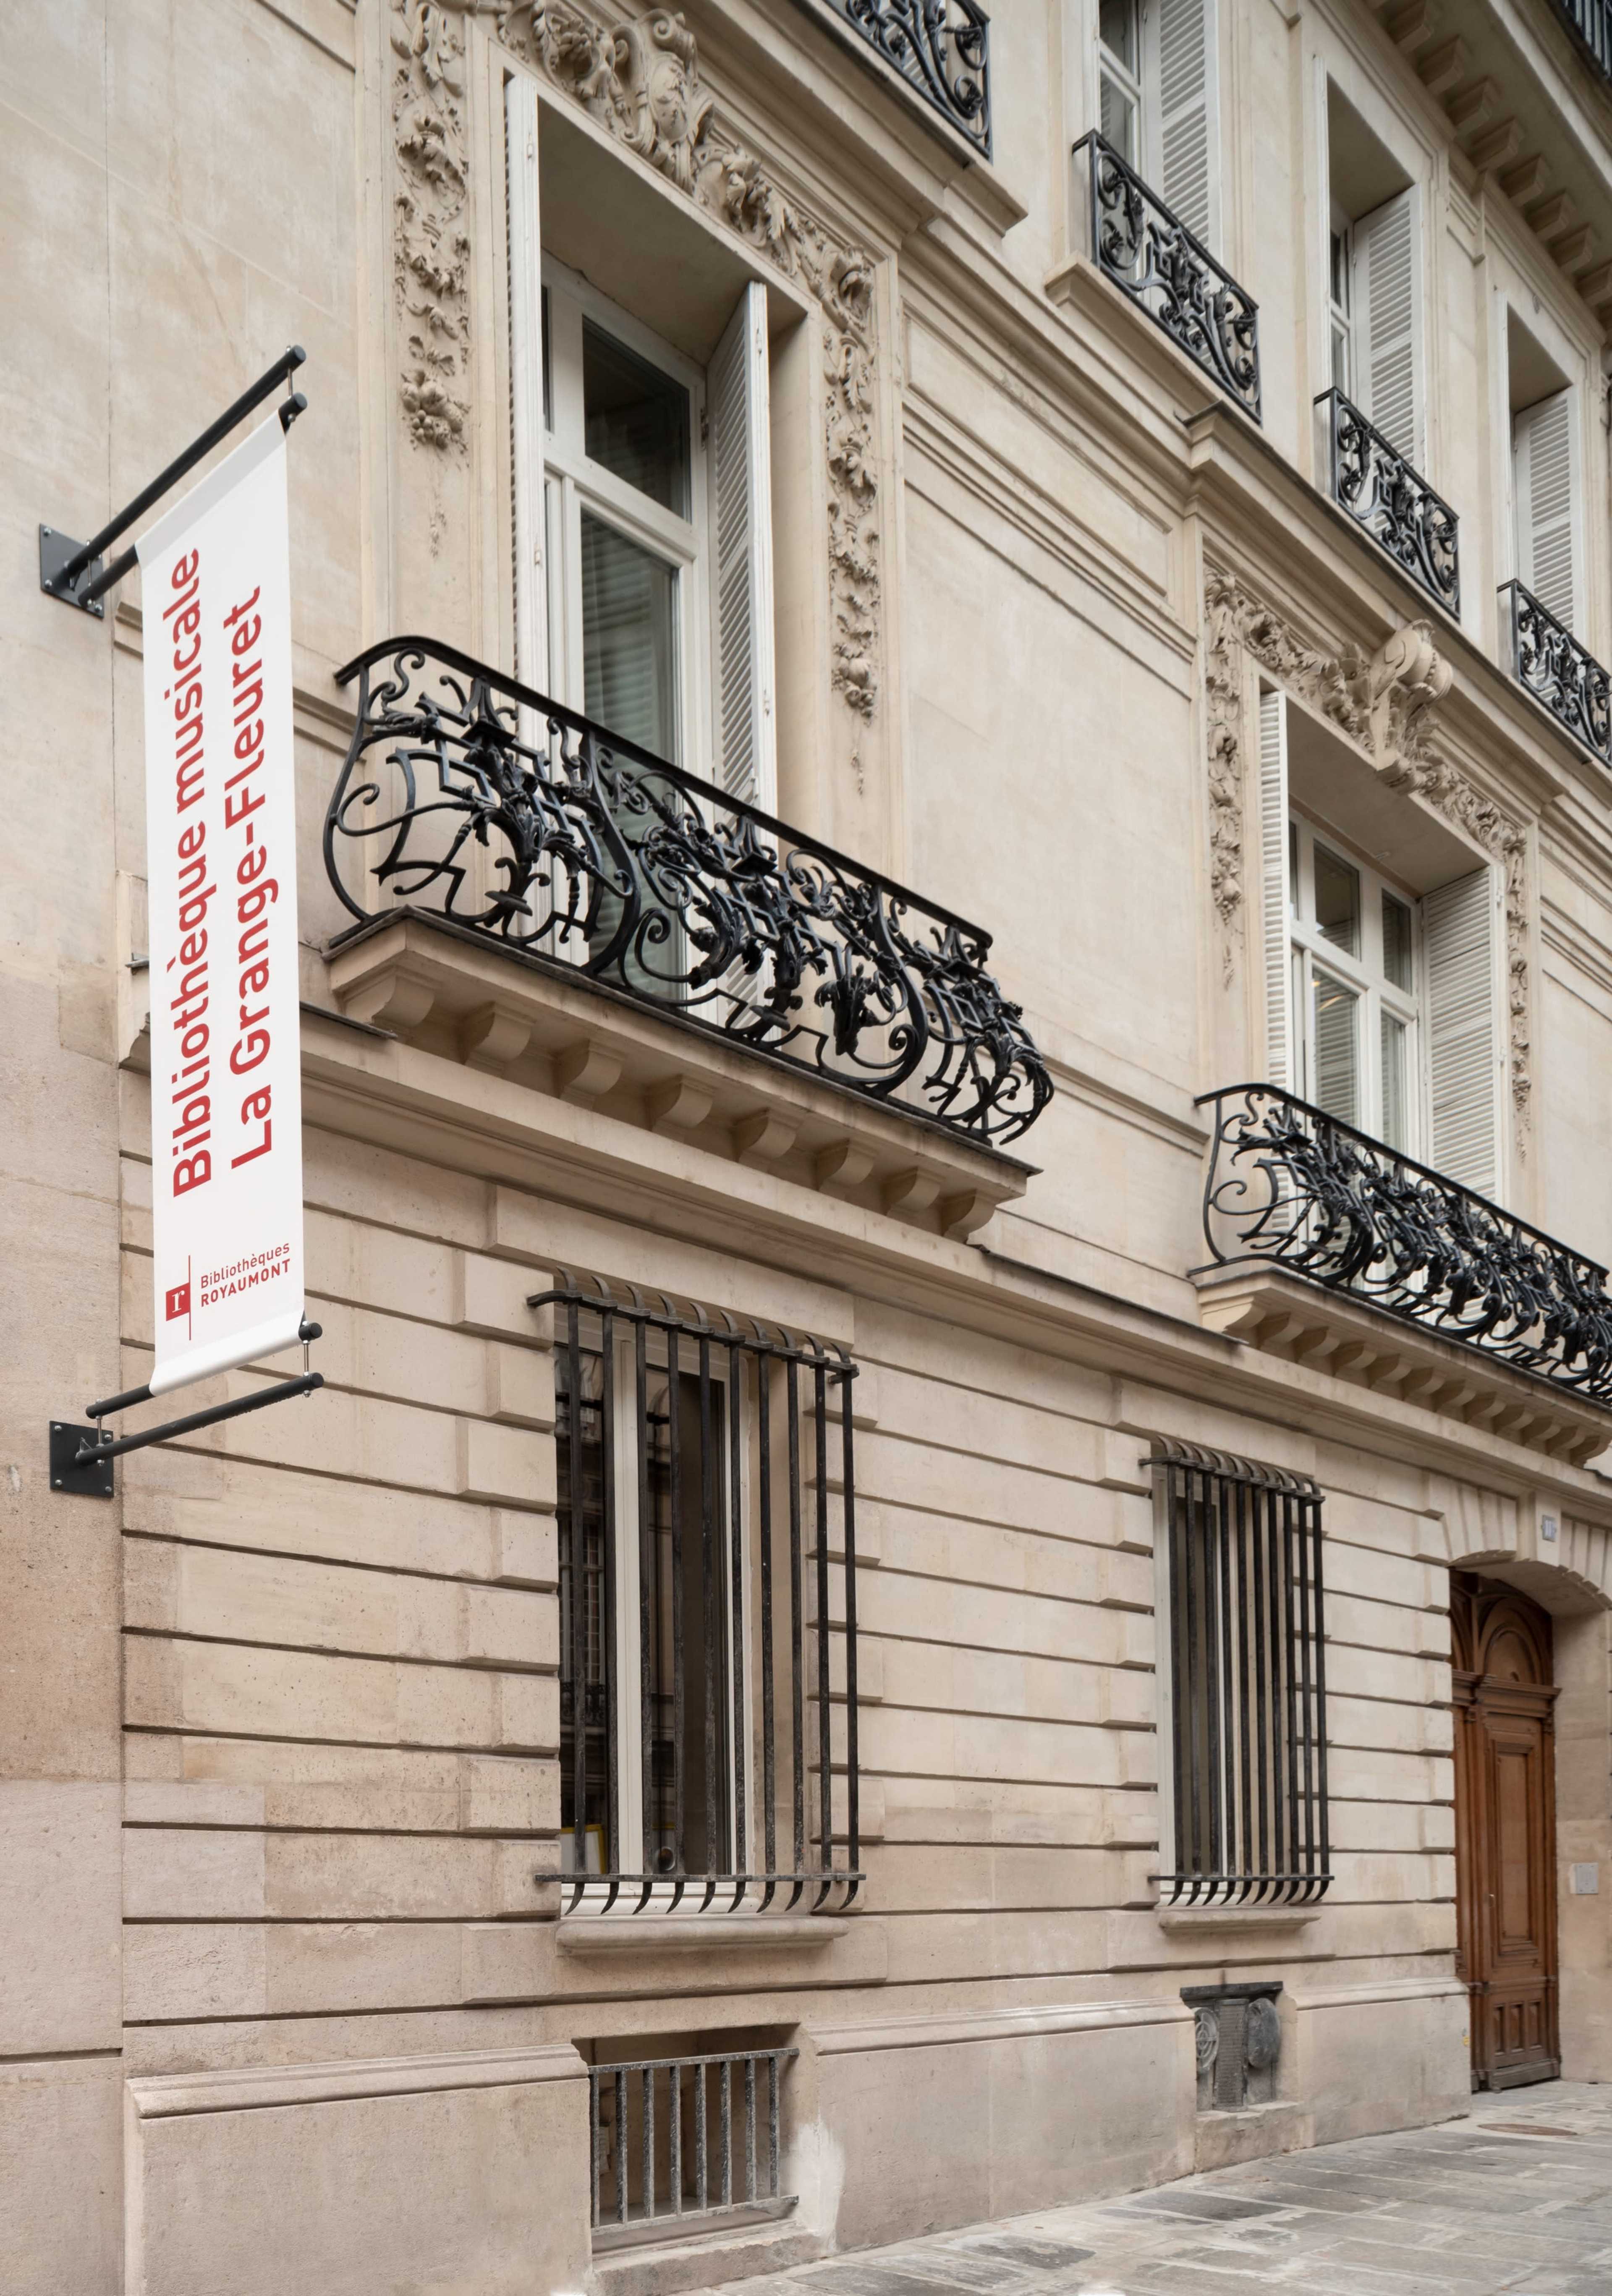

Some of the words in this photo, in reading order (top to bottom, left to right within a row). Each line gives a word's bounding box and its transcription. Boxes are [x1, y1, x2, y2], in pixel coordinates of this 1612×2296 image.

[162, 548, 205, 814] musicale
[222, 586, 279, 1075] Grange-Fleuret
[166, 821, 217, 1197] Bibliothèque
[230, 1084, 272, 1169] La
[201, 1242, 290, 1289] Bibliothèques
[201, 1258, 290, 1308] ROYAUMONT
